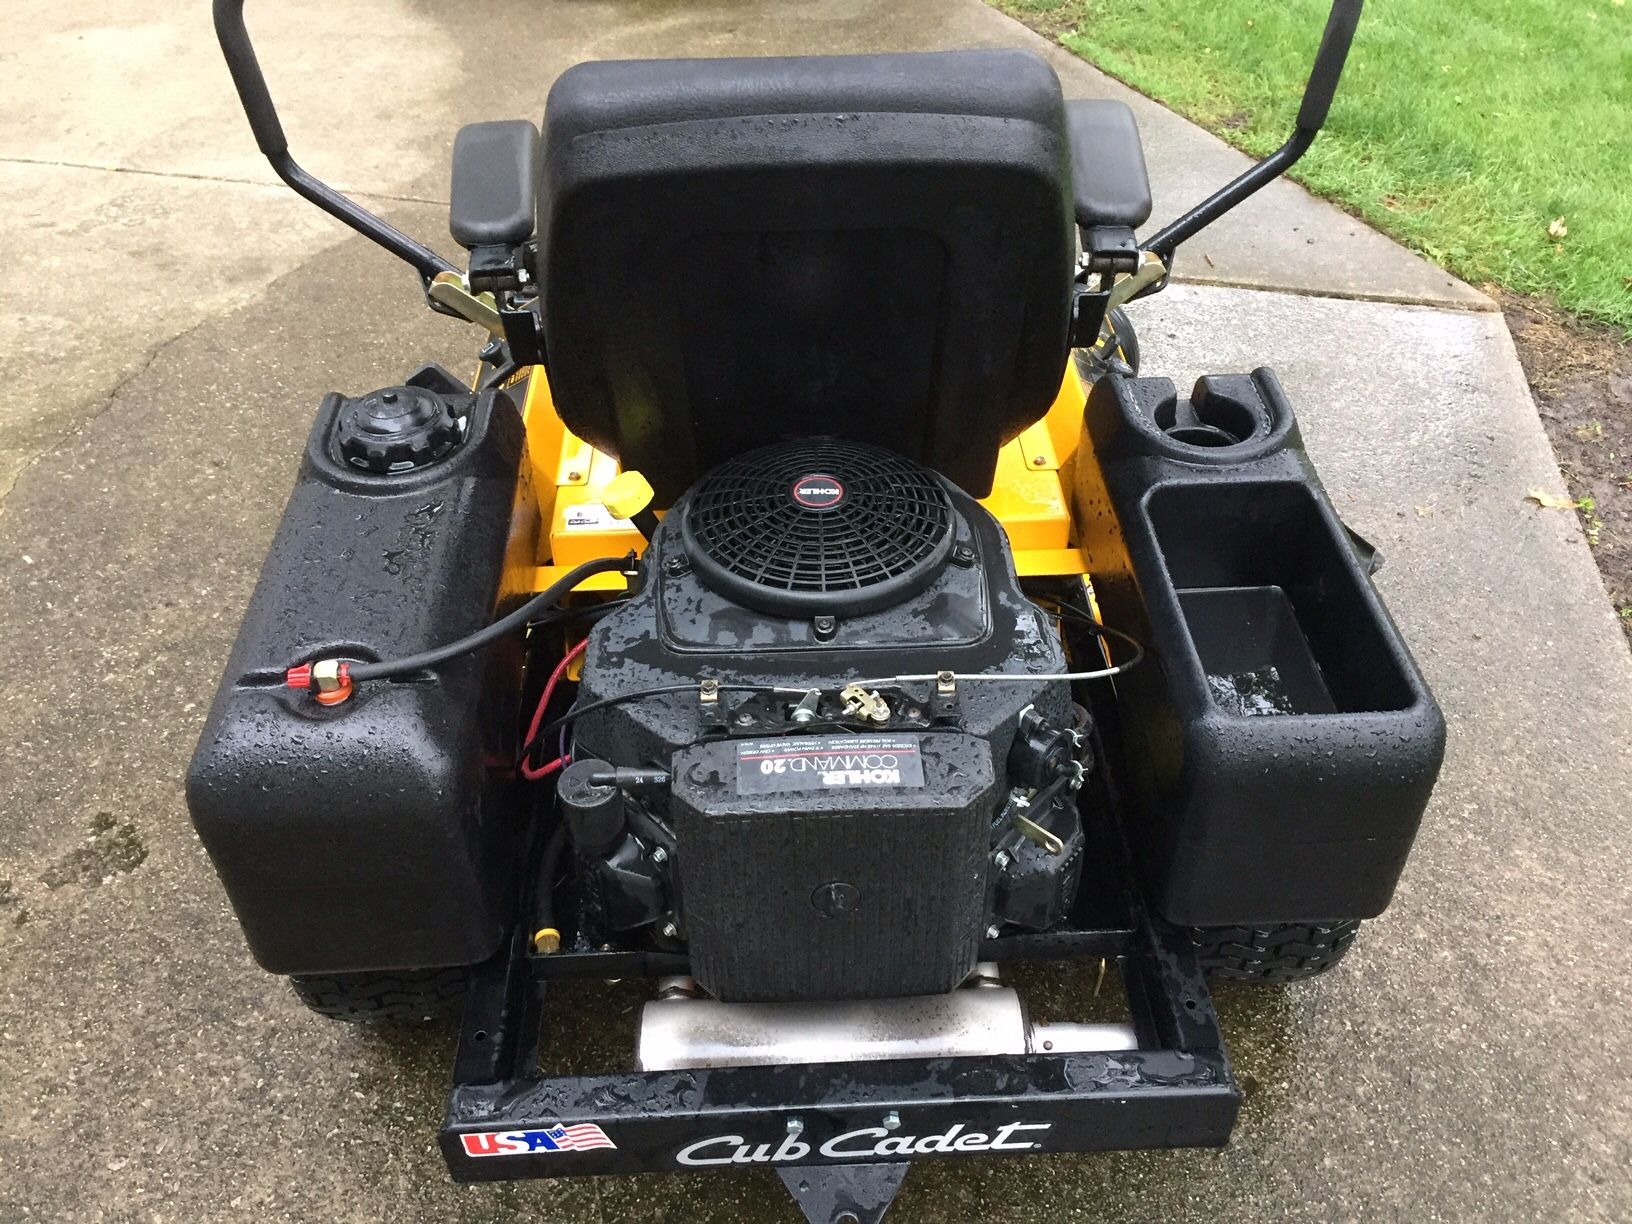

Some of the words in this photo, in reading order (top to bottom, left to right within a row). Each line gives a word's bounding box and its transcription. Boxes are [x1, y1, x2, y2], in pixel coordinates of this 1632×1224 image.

[760, 758, 786, 774] 20
[635, 776, 644, 784] 24
[822, 769, 900, 785] KOHLER
[464, 1131, 560, 1155] USA
[675, 1131, 812, 1167] Cub
[819, 1121, 1052, 1158] Cadet
